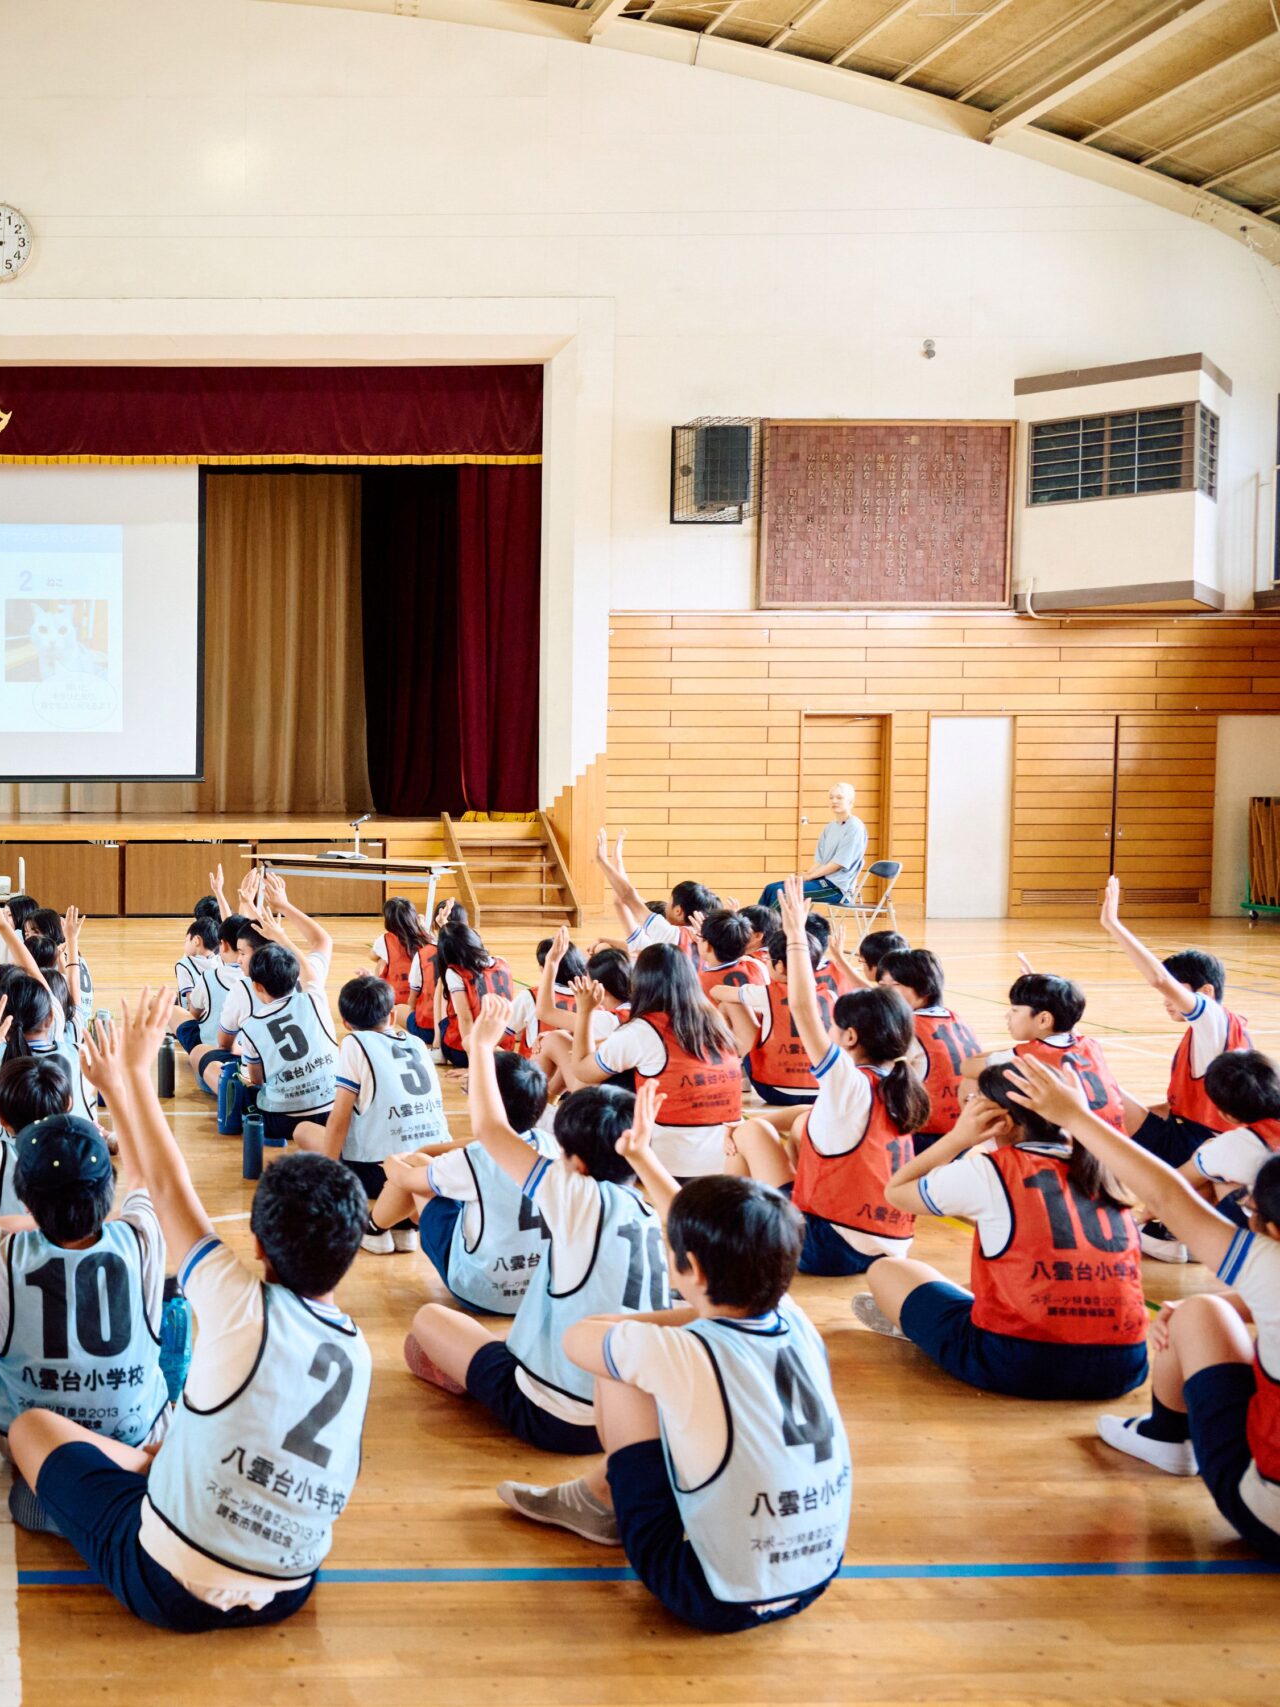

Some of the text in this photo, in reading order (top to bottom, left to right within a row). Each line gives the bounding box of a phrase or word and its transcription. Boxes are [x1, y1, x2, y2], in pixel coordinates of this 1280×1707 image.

[6, 216, 12, 226] 1
[14, 224, 22, 234] 2
[18, 237, 26, 247] 3
[5, 259, 12, 269] 5
[13, 250, 21, 260] 4
[19, 570, 33, 592] 2
[47, 577, 63, 588] ねこ
[266, 1013, 309, 1062] 5
[391, 1043, 431, 1096] 3
[493, 1252, 541, 1272] 八雲台
[25, 1252, 131, 1359] 10
[22, 1364, 144, 1392] 八雲台小学校
[281, 1342, 353, 1469] 2
[775, 1345, 834, 1465] 4
[221, 1446, 346, 1516] 八雲台小学校
